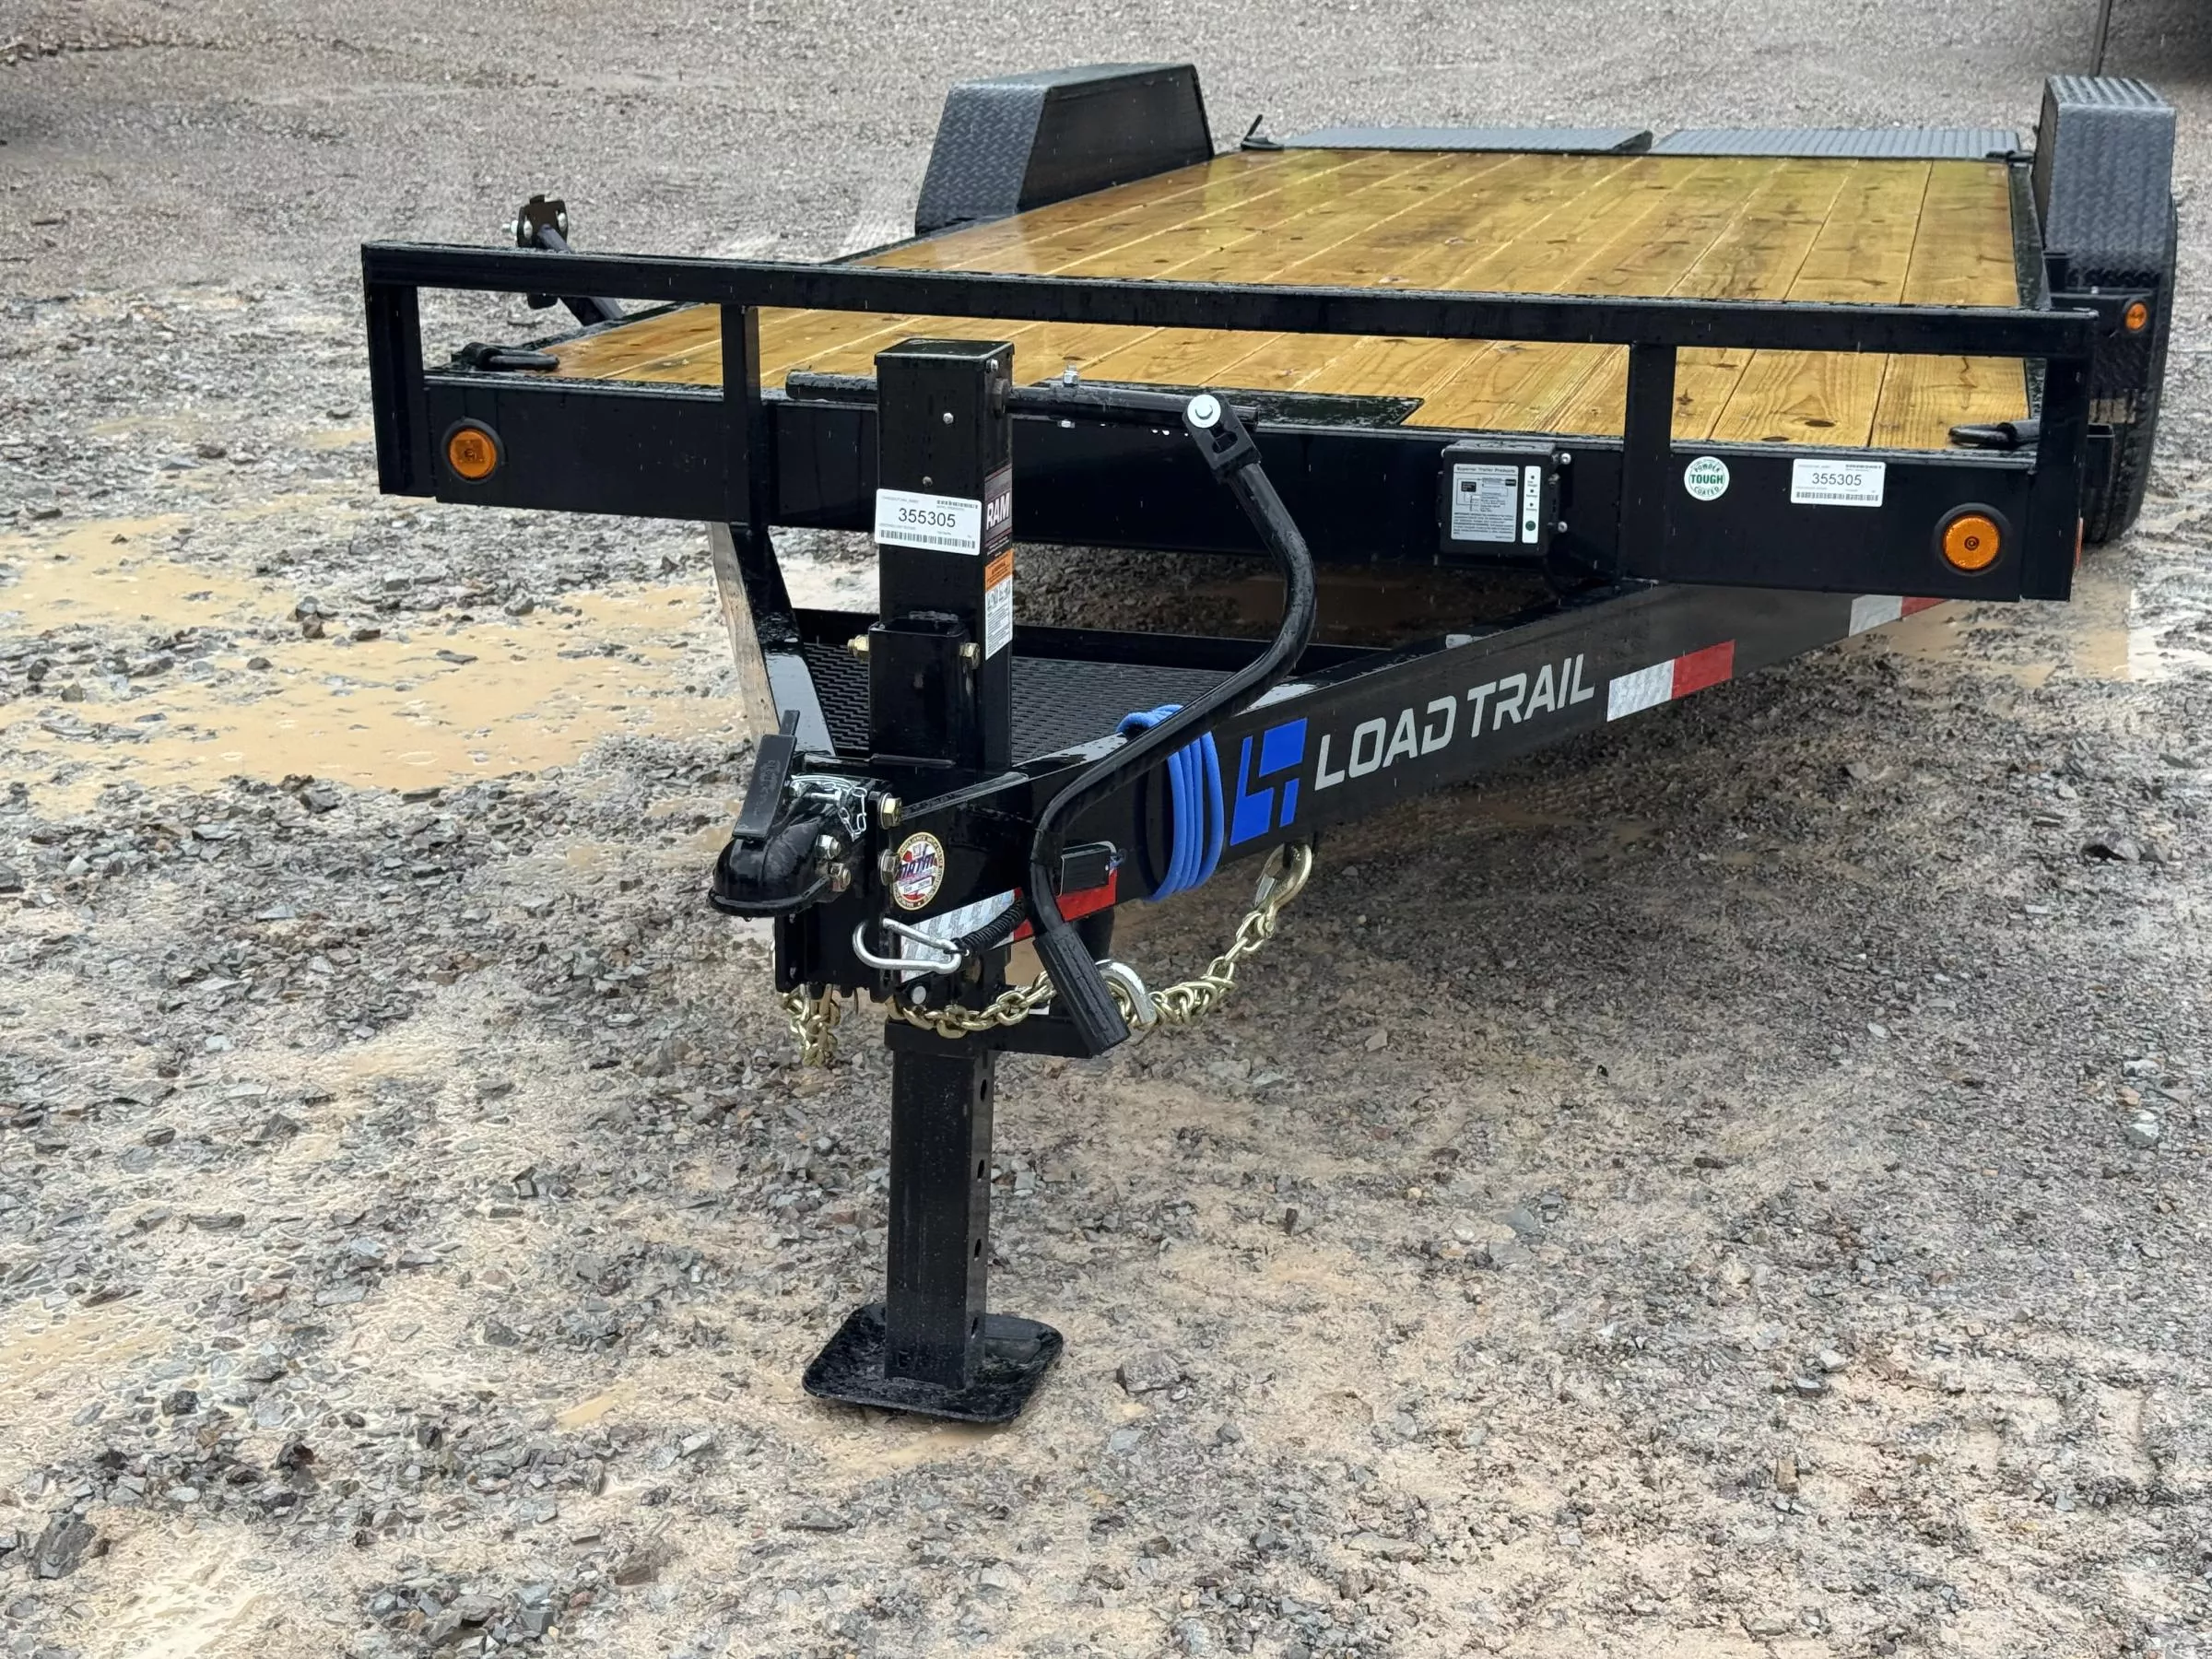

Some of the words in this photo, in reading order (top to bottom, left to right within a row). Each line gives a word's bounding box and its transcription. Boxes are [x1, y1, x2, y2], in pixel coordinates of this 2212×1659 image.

[1689, 474, 1724, 485] TOUGH
[1812, 472, 1863, 487] 355305
[898, 507, 956, 528] 355305
[986, 492, 1010, 531] RAM
[1314, 695, 1456, 791] LOAD
[1466, 653, 1595, 738] TRAIL
